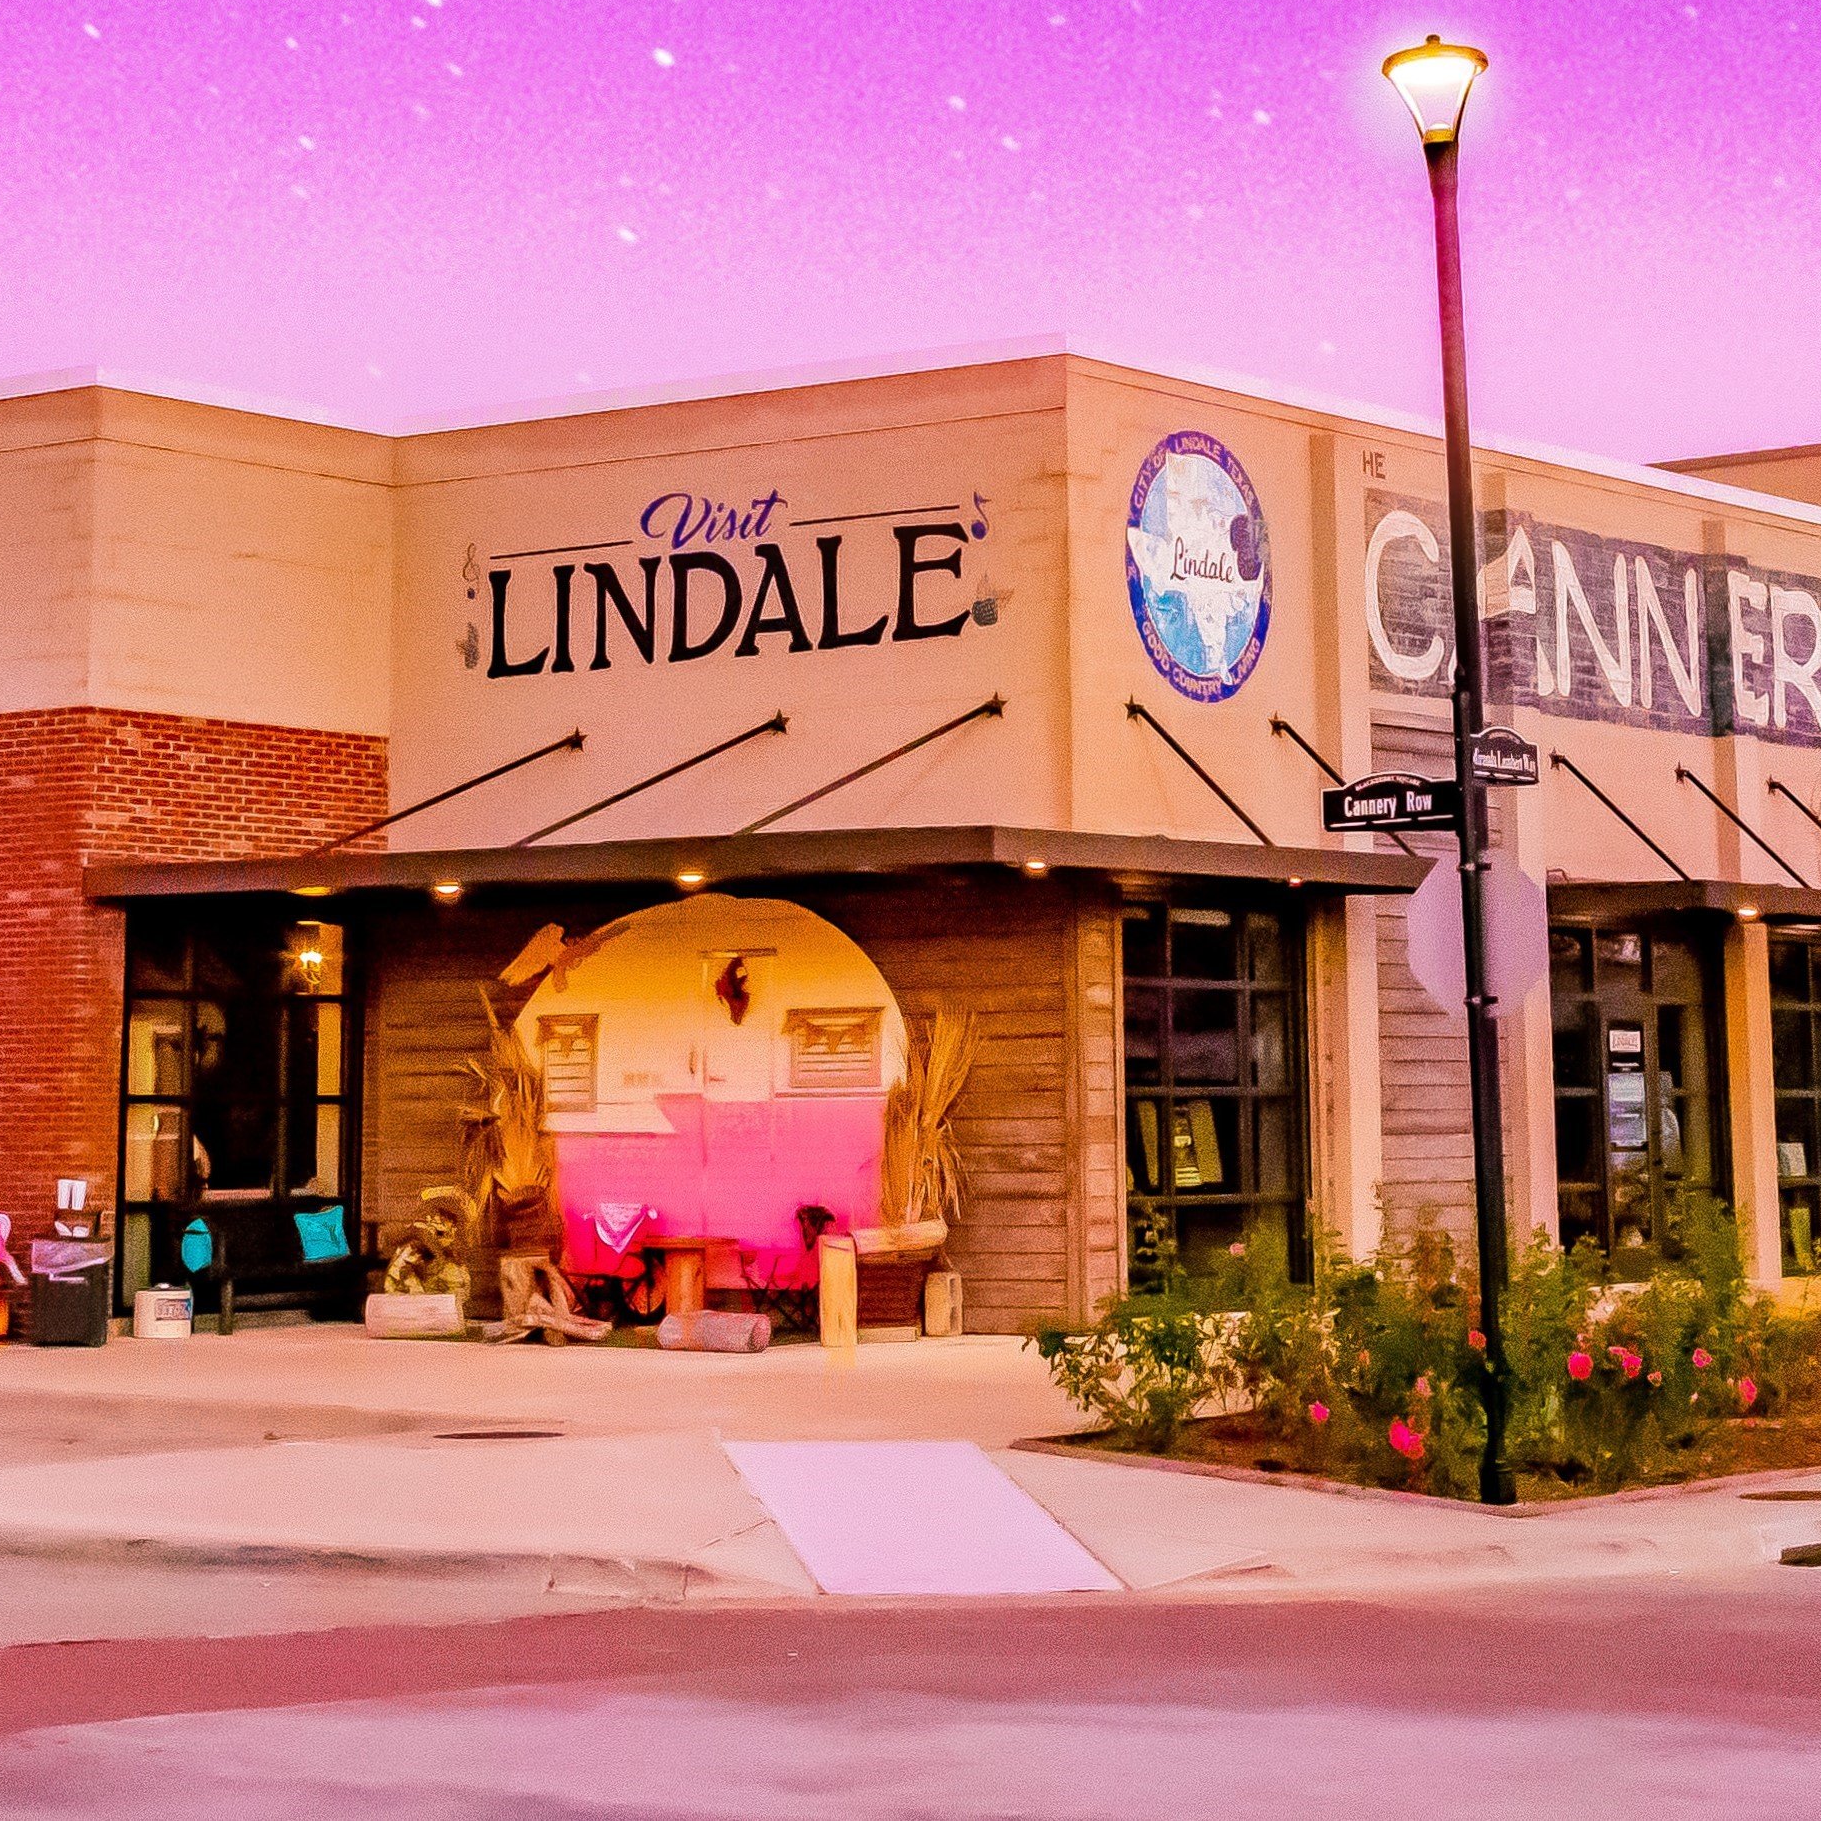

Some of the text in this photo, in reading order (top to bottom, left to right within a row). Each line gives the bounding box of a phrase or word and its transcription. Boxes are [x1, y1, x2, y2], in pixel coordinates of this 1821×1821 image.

[640, 489, 788, 549] Visit
[1170, 536, 1234, 583] Lindale
[486, 522, 973, 679] LINDALE
[1344, 790, 1433, 819] Cannery Row
